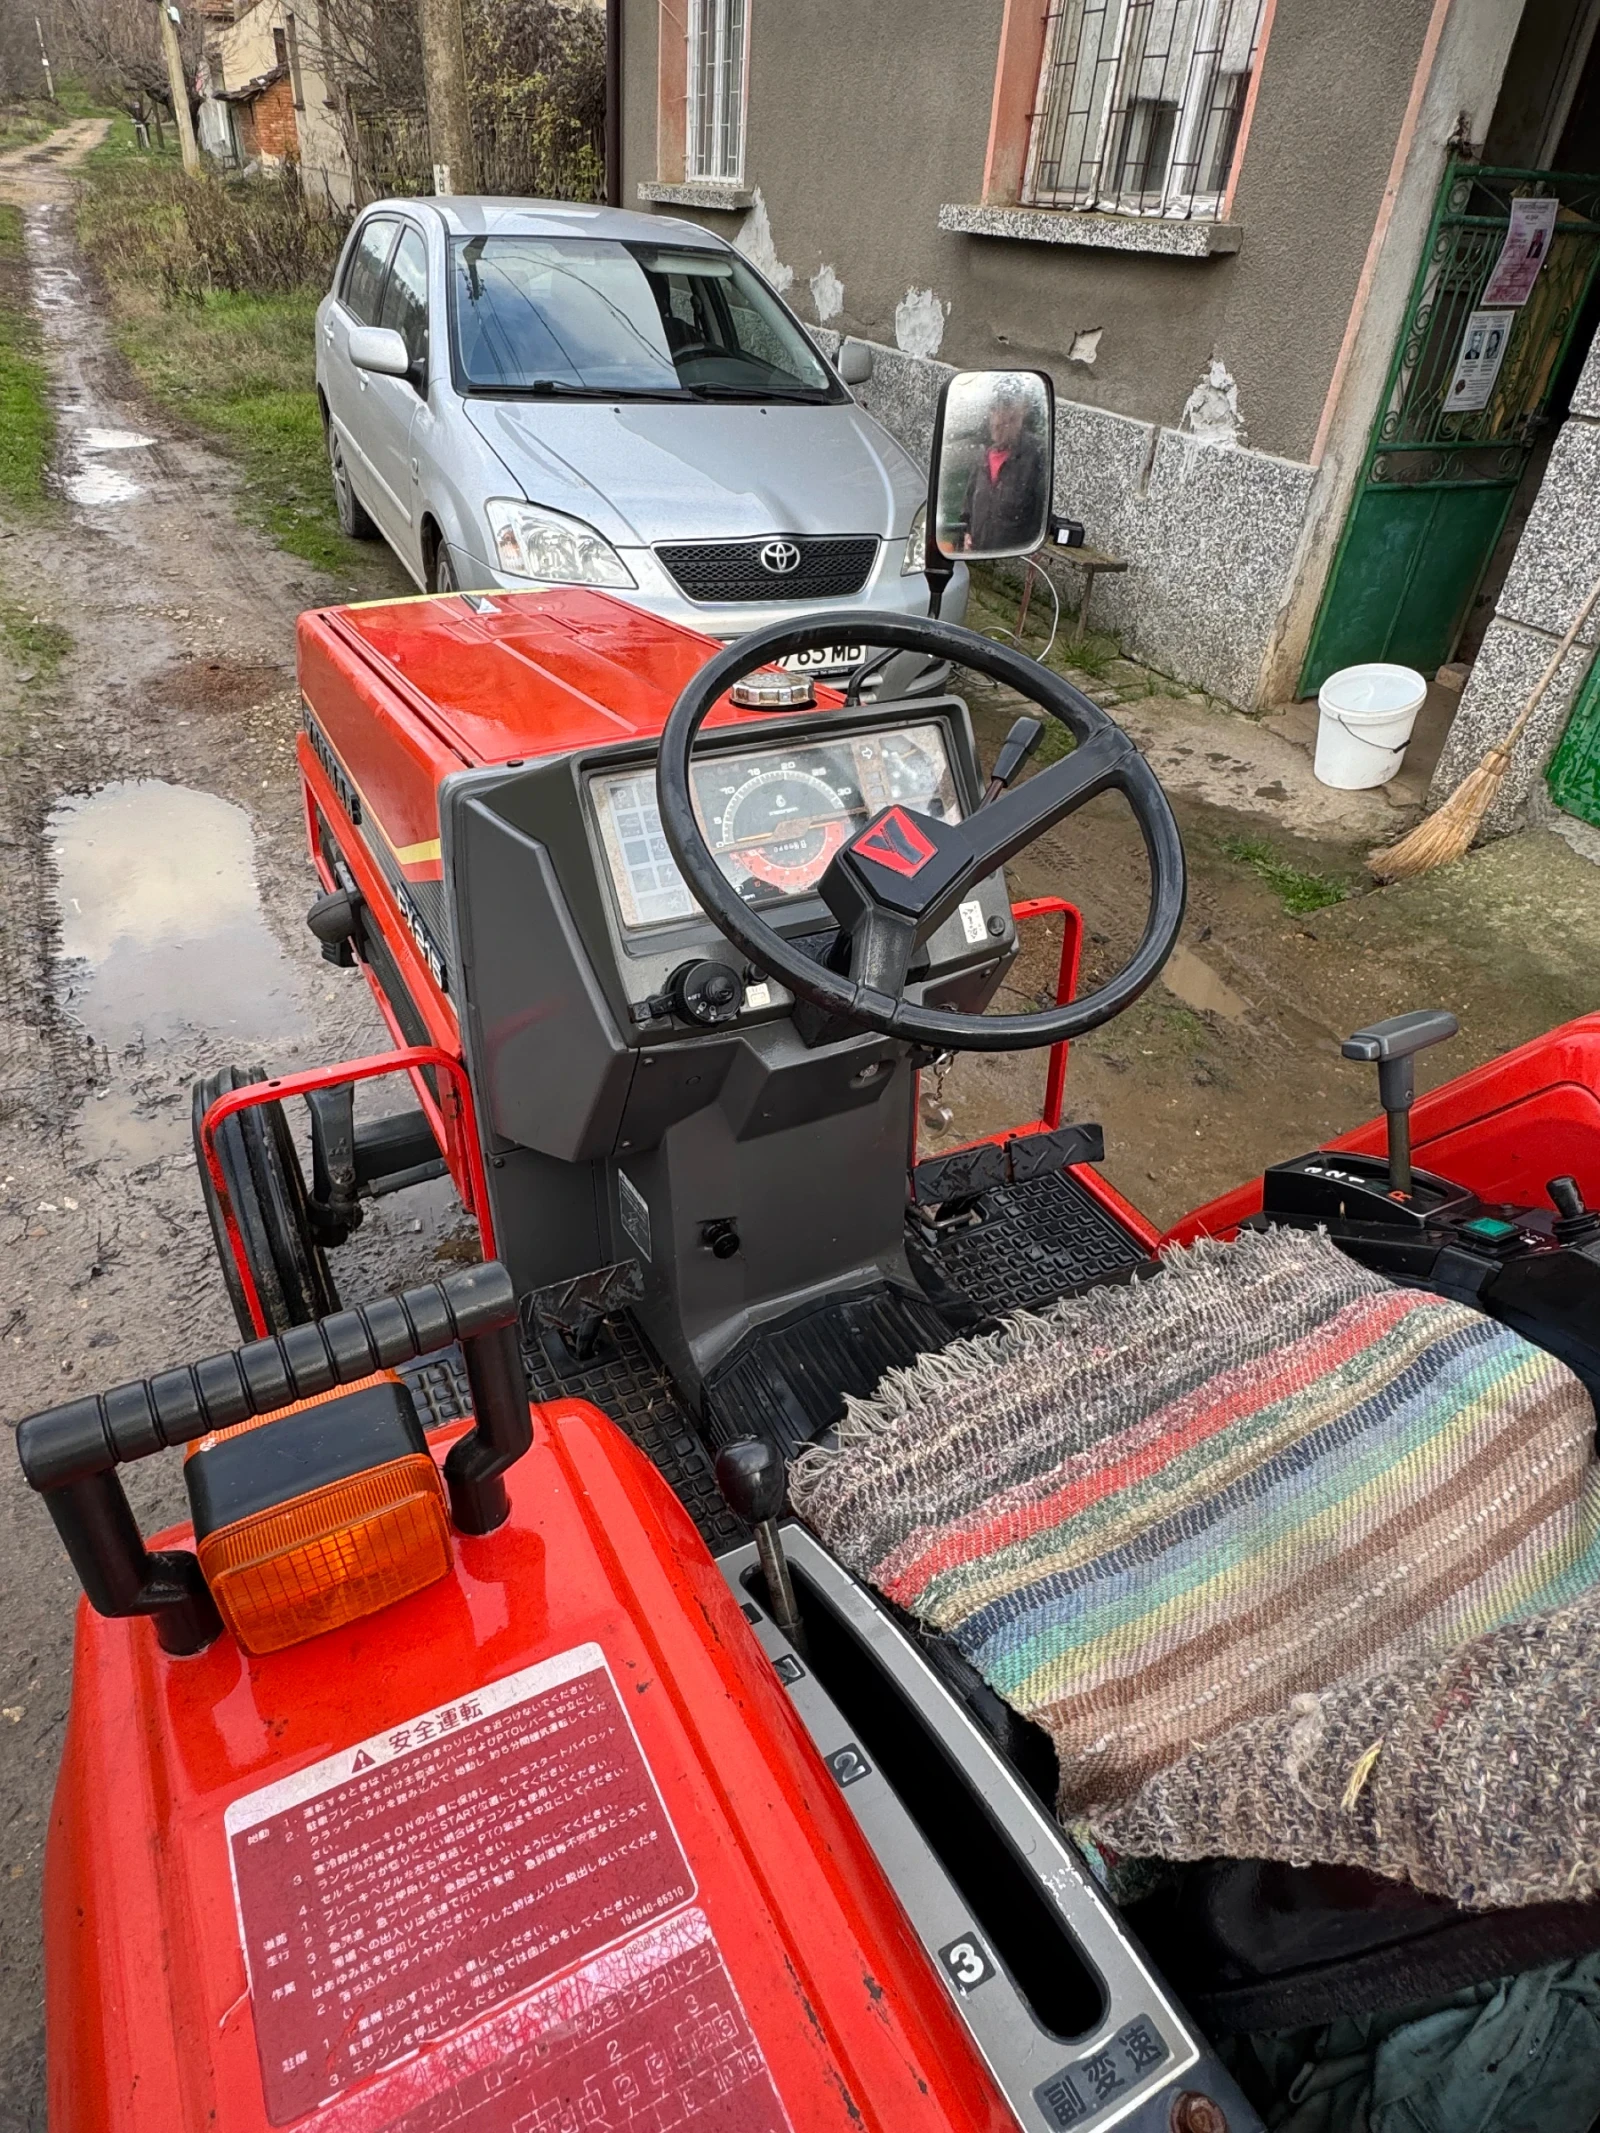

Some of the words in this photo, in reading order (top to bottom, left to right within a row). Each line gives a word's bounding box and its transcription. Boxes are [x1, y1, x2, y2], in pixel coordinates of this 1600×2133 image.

[1304, 1166, 1323, 1174] 3
[1325, 1170, 1347, 1178] 2
[1348, 1176, 1365, 1184] 1
[1388, 1190, 1413, 1203] R
[388, 1699, 484, 1755] 安全運転
[833, 1751, 866, 1783] 2
[618, 1884, 686, 1928] 194940-65310
[949, 1943, 984, 1983] 3
[606, 2040, 621, 2061] 2
[685, 1994, 700, 2014] 3
[620, 2076, 635, 2099] 2
[1043, 2023, 1161, 2127] 副変速
